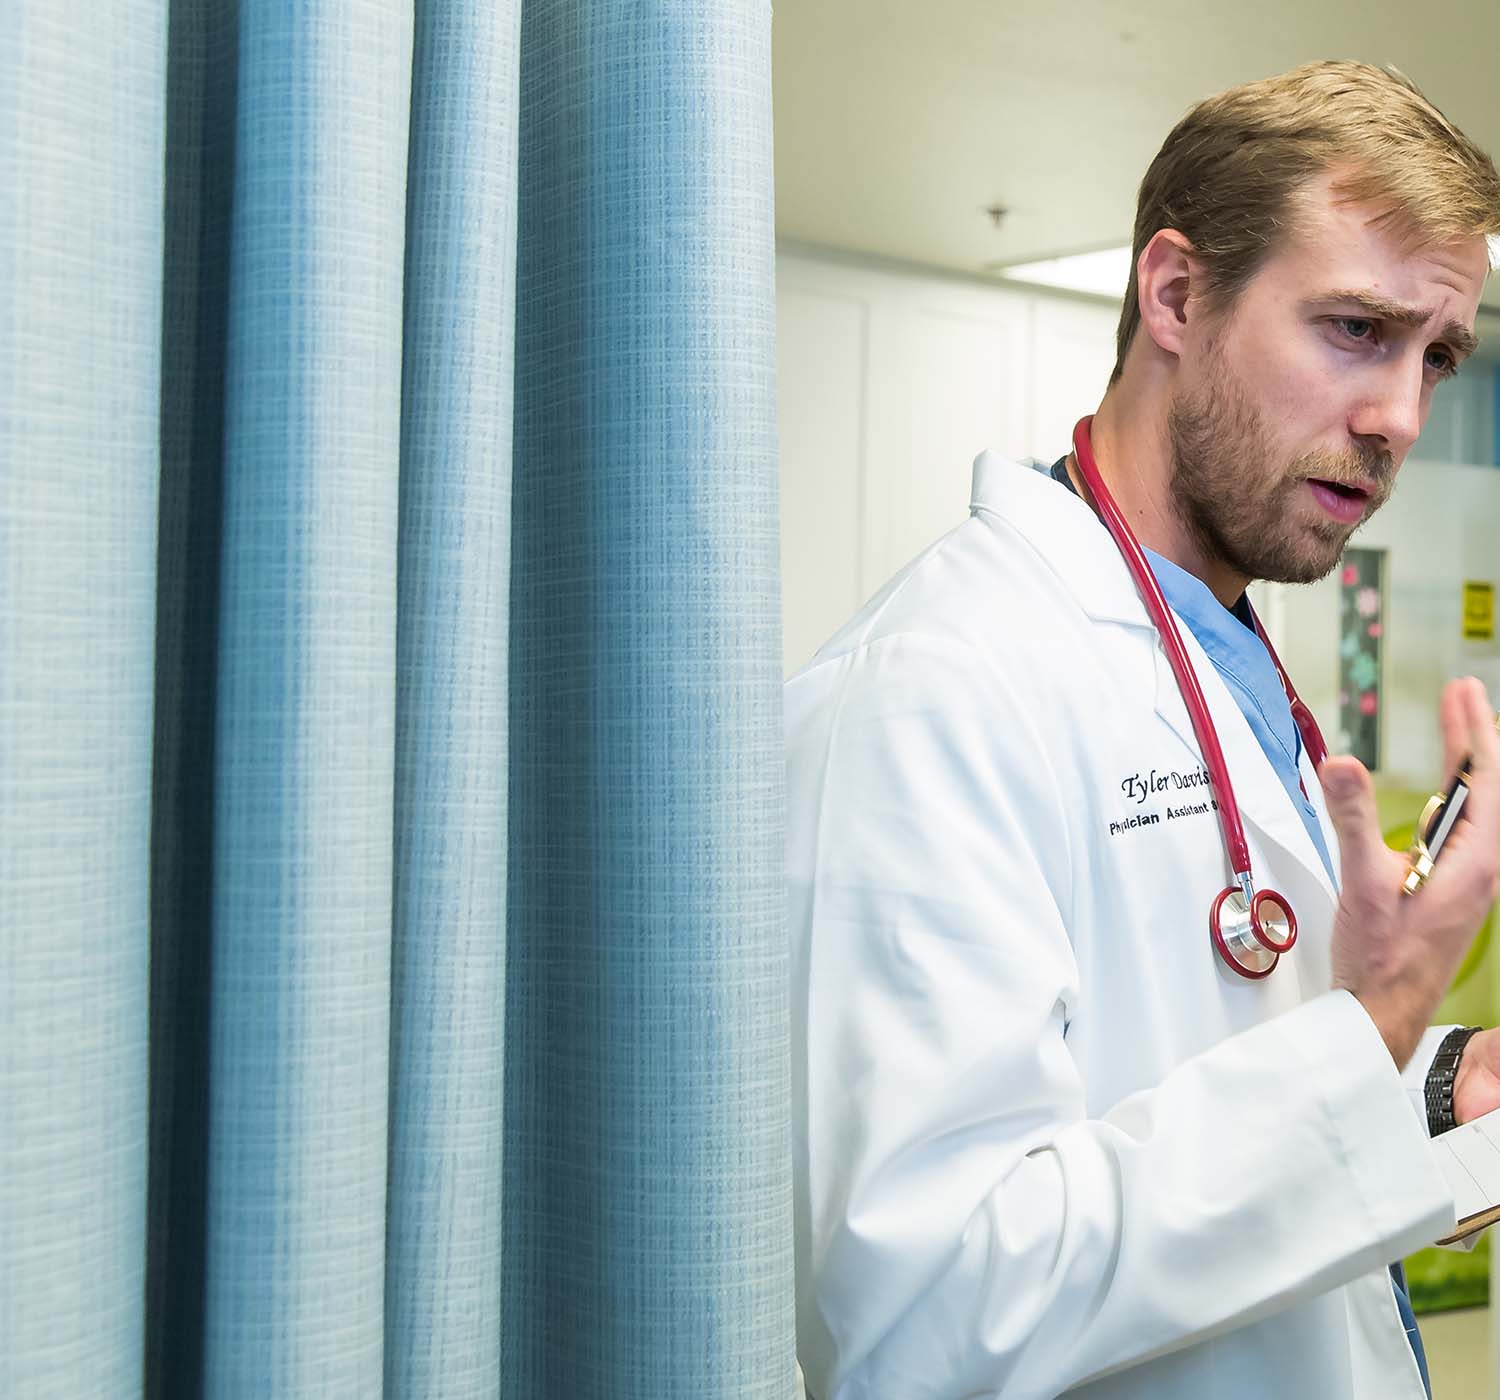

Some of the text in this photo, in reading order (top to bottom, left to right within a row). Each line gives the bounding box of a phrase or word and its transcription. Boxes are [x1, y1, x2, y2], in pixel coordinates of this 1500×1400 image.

[1121, 766, 1209, 804] Tyler Davis
[1110, 814, 1159, 835] Physician
[1167, 802, 1209, 820] Assistant
